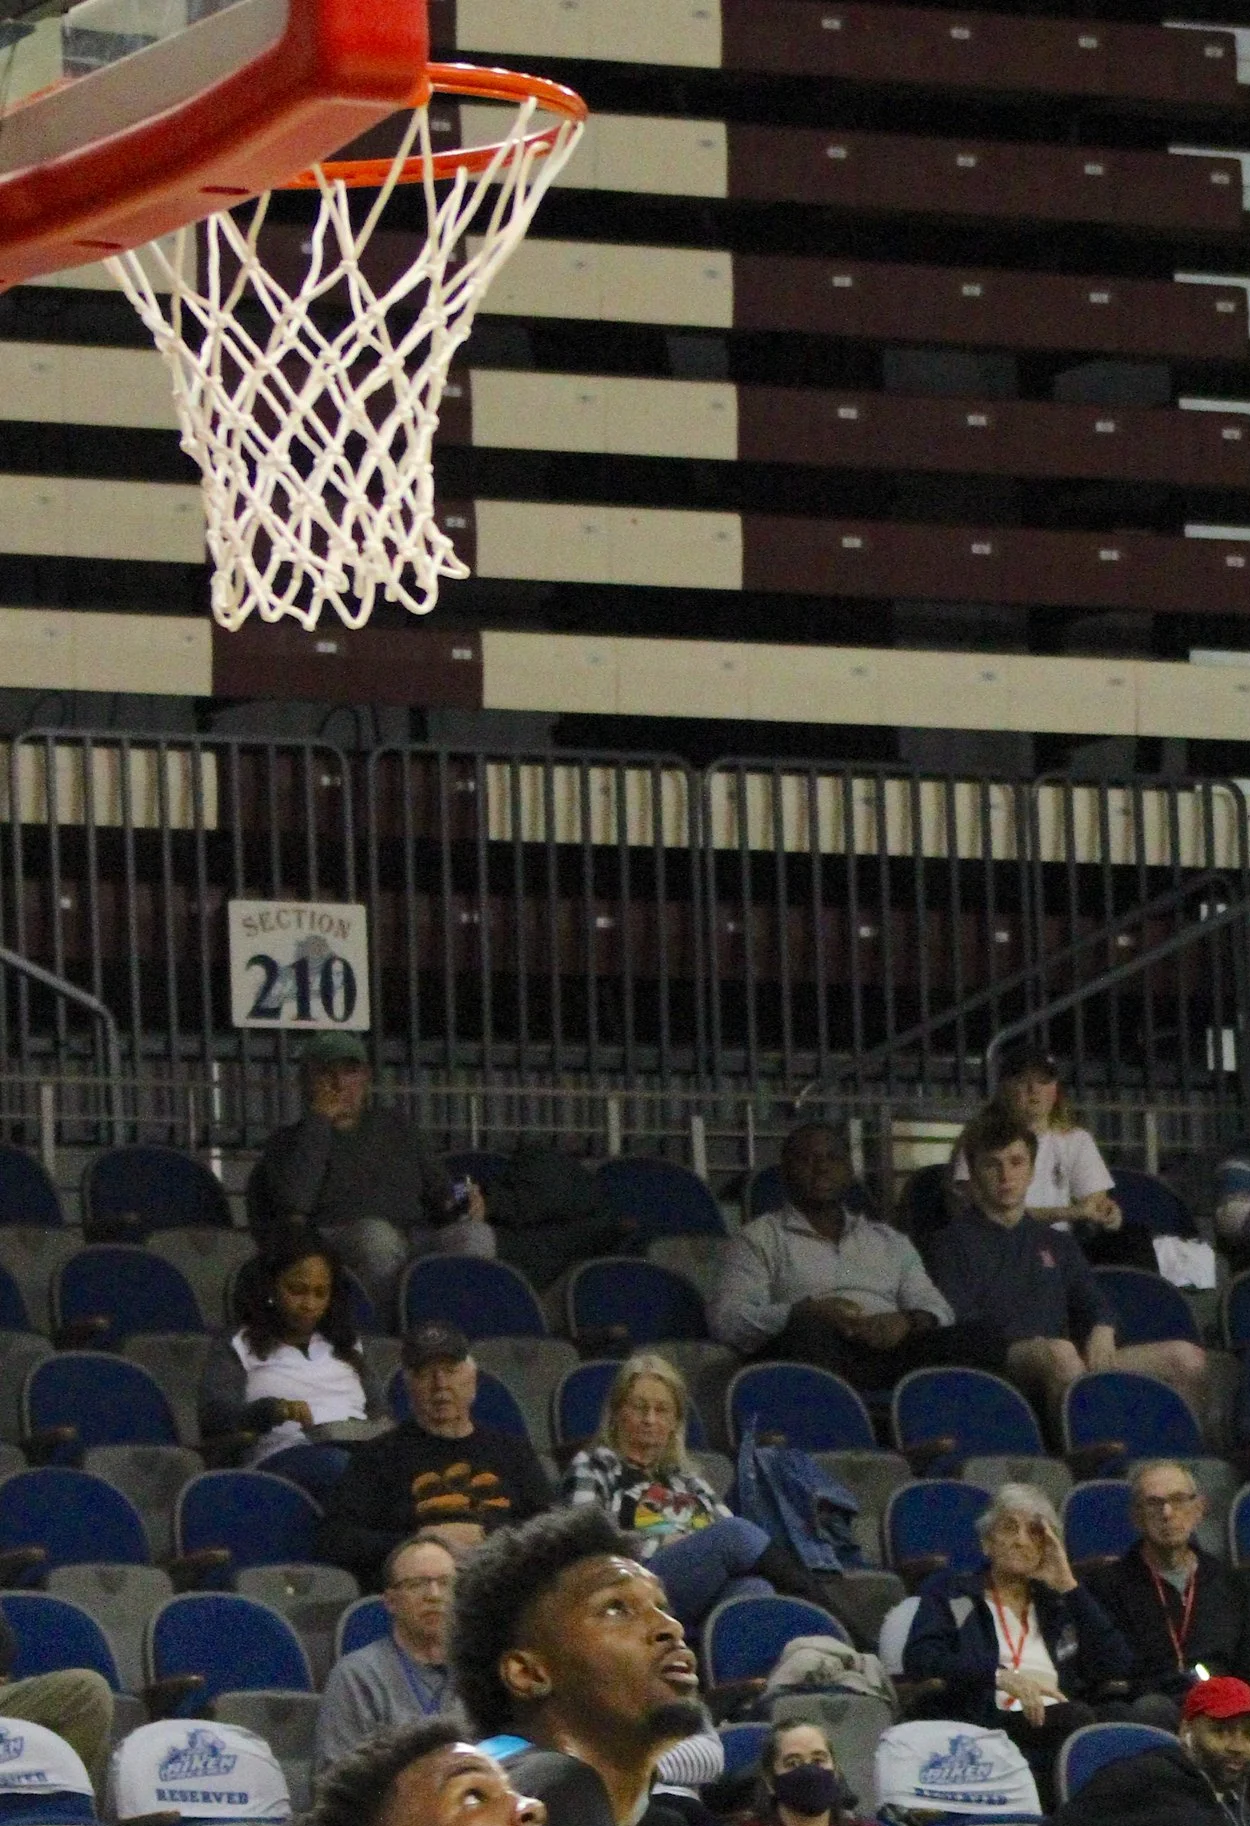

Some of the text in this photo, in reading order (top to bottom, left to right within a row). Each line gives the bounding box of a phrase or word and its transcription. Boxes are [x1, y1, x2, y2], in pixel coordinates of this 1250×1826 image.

[242, 909, 351, 940] SECTION
[246, 953, 357, 1023] 210
[156, 1788, 249, 1805] RESERVED
